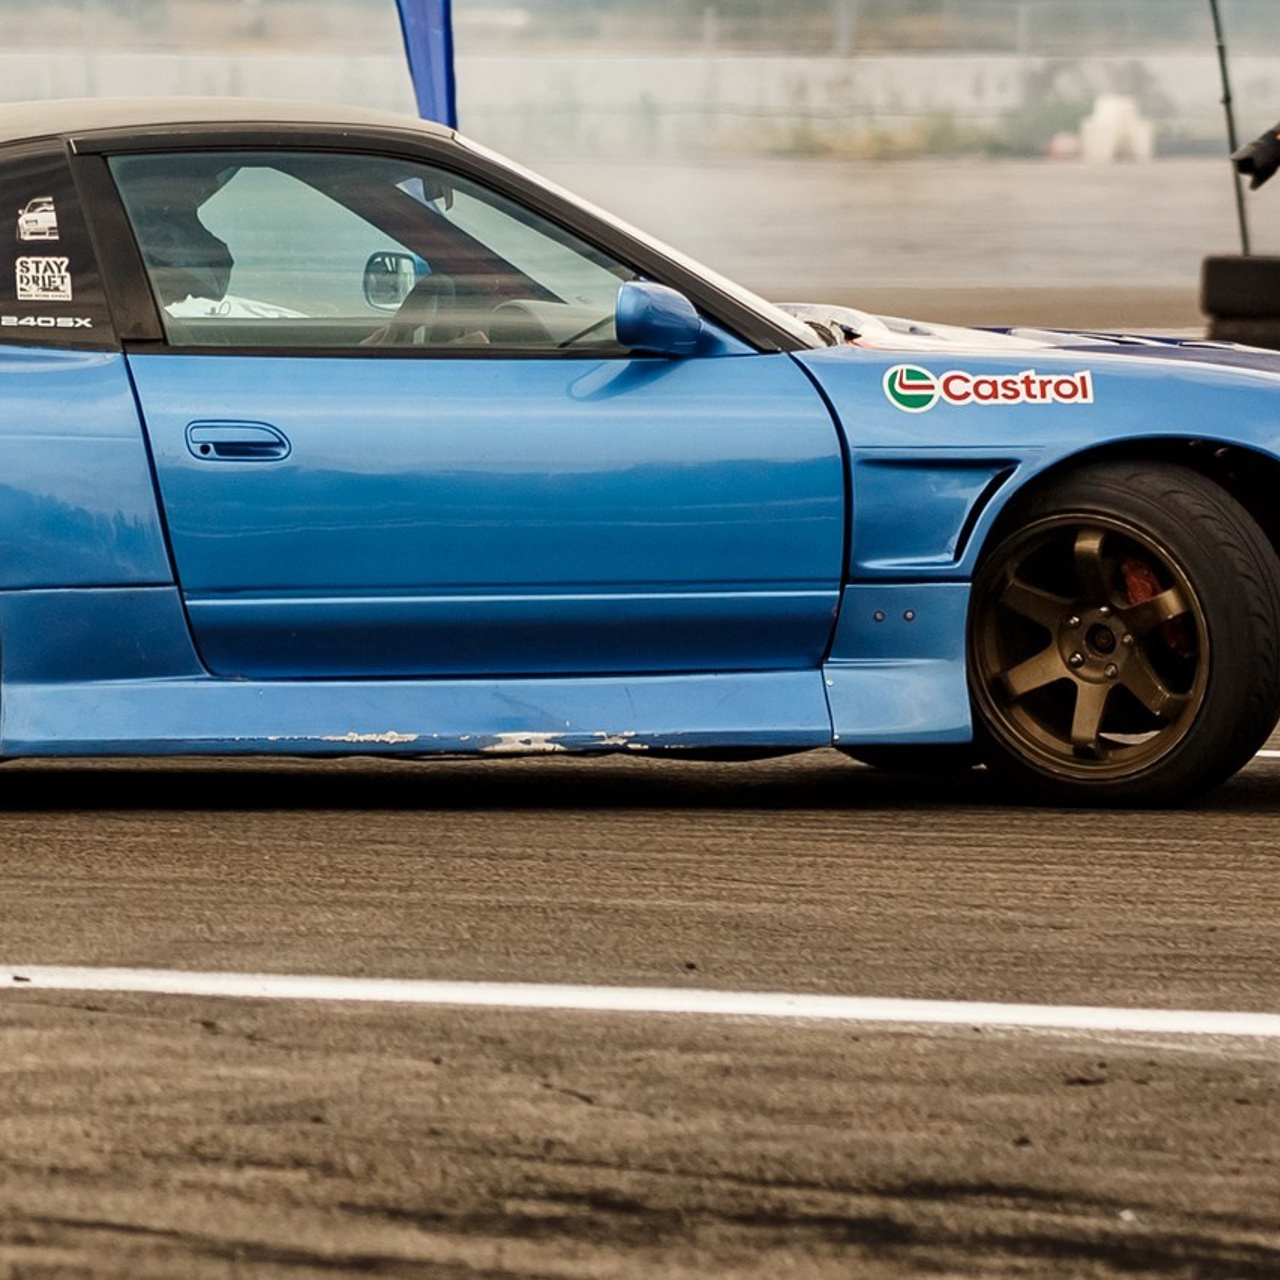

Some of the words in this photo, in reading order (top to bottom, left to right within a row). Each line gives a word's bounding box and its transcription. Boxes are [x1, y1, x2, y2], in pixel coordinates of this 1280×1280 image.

[19, 260, 66, 274] STAY
[19, 274, 68, 287] DRIFT
[0, 315, 93, 328] 240SX
[942, 374, 1088, 401] Castrol
